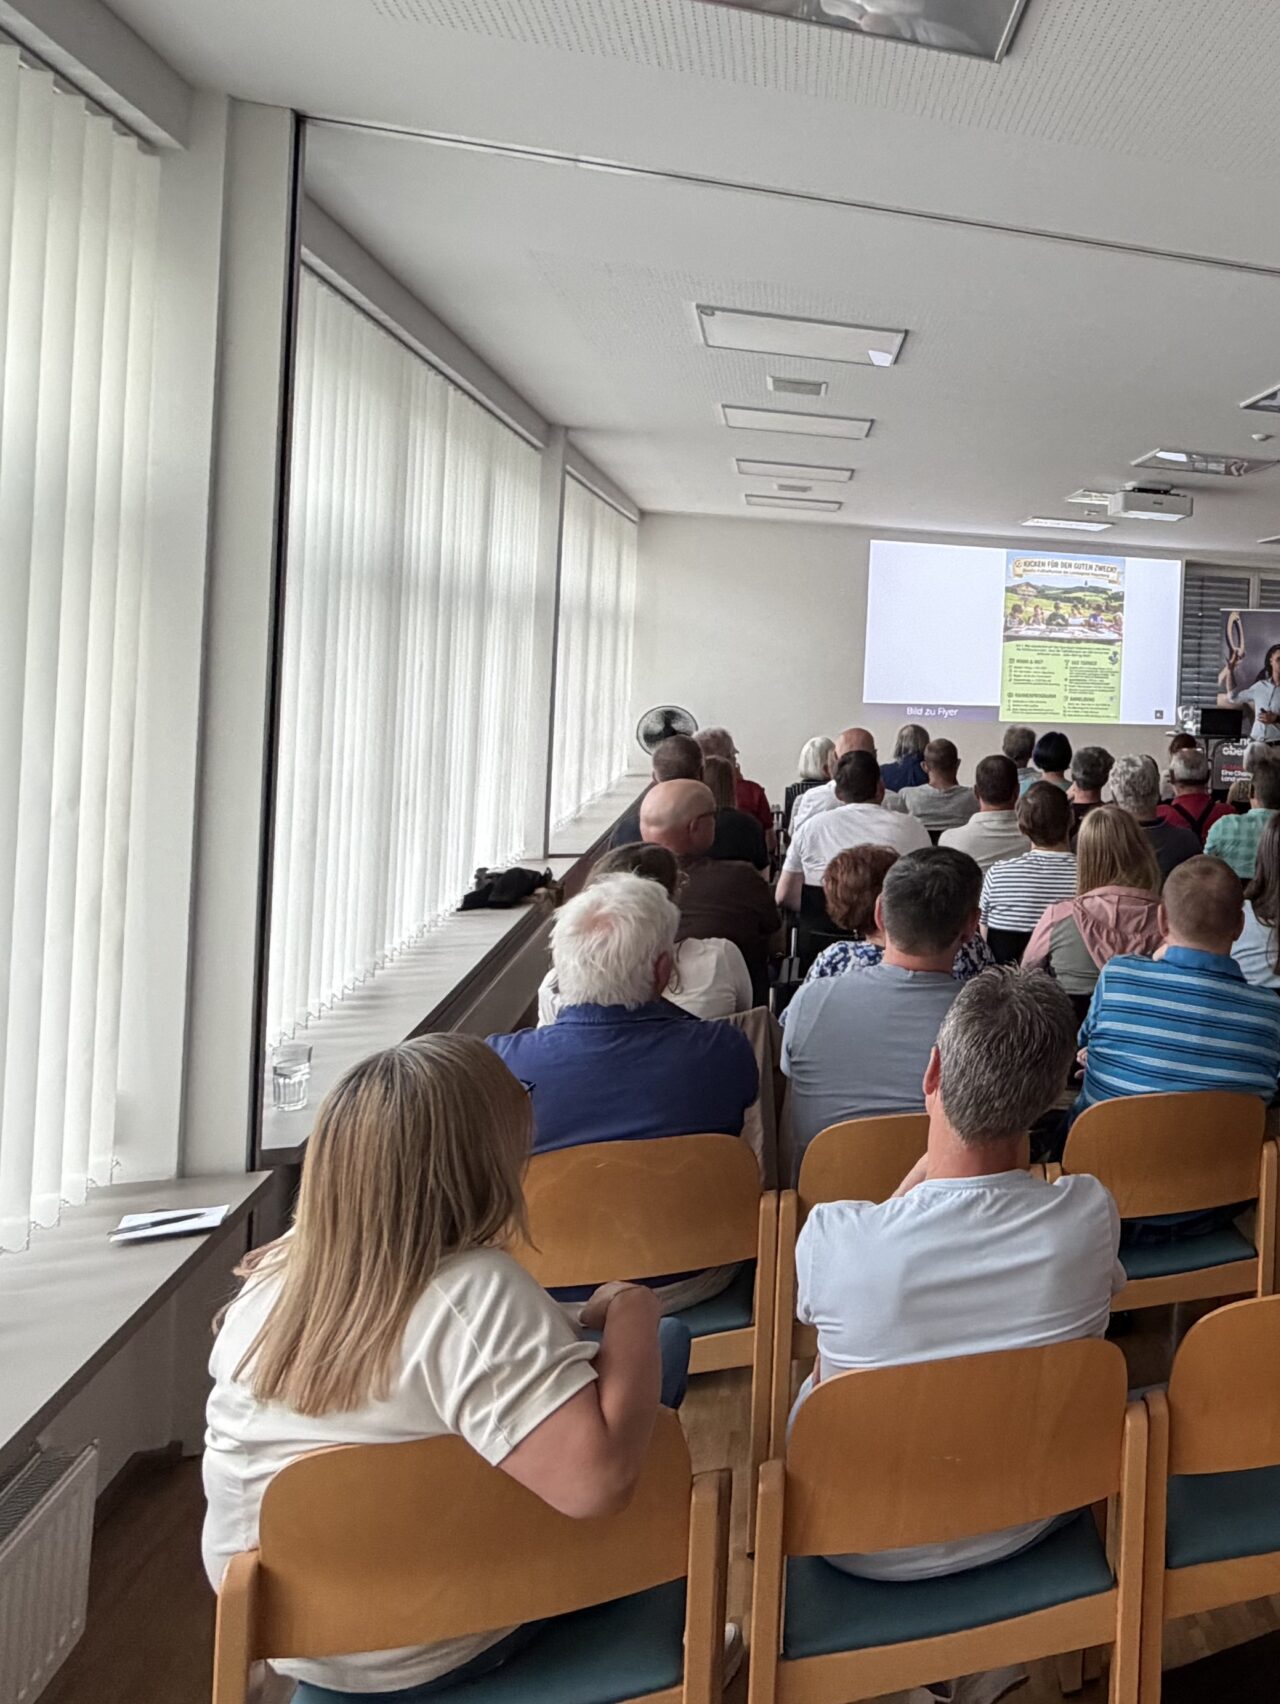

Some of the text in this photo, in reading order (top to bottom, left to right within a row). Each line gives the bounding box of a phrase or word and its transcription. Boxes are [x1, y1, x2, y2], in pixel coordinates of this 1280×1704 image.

[1023, 560, 1046, 568] KICKEN
[1047, 559, 1059, 569] FÜR
[1060, 561, 1072, 570] DEN
[1073, 562, 1093, 571] GUTEN
[906, 706, 959, 719] Bild zu Flyer
